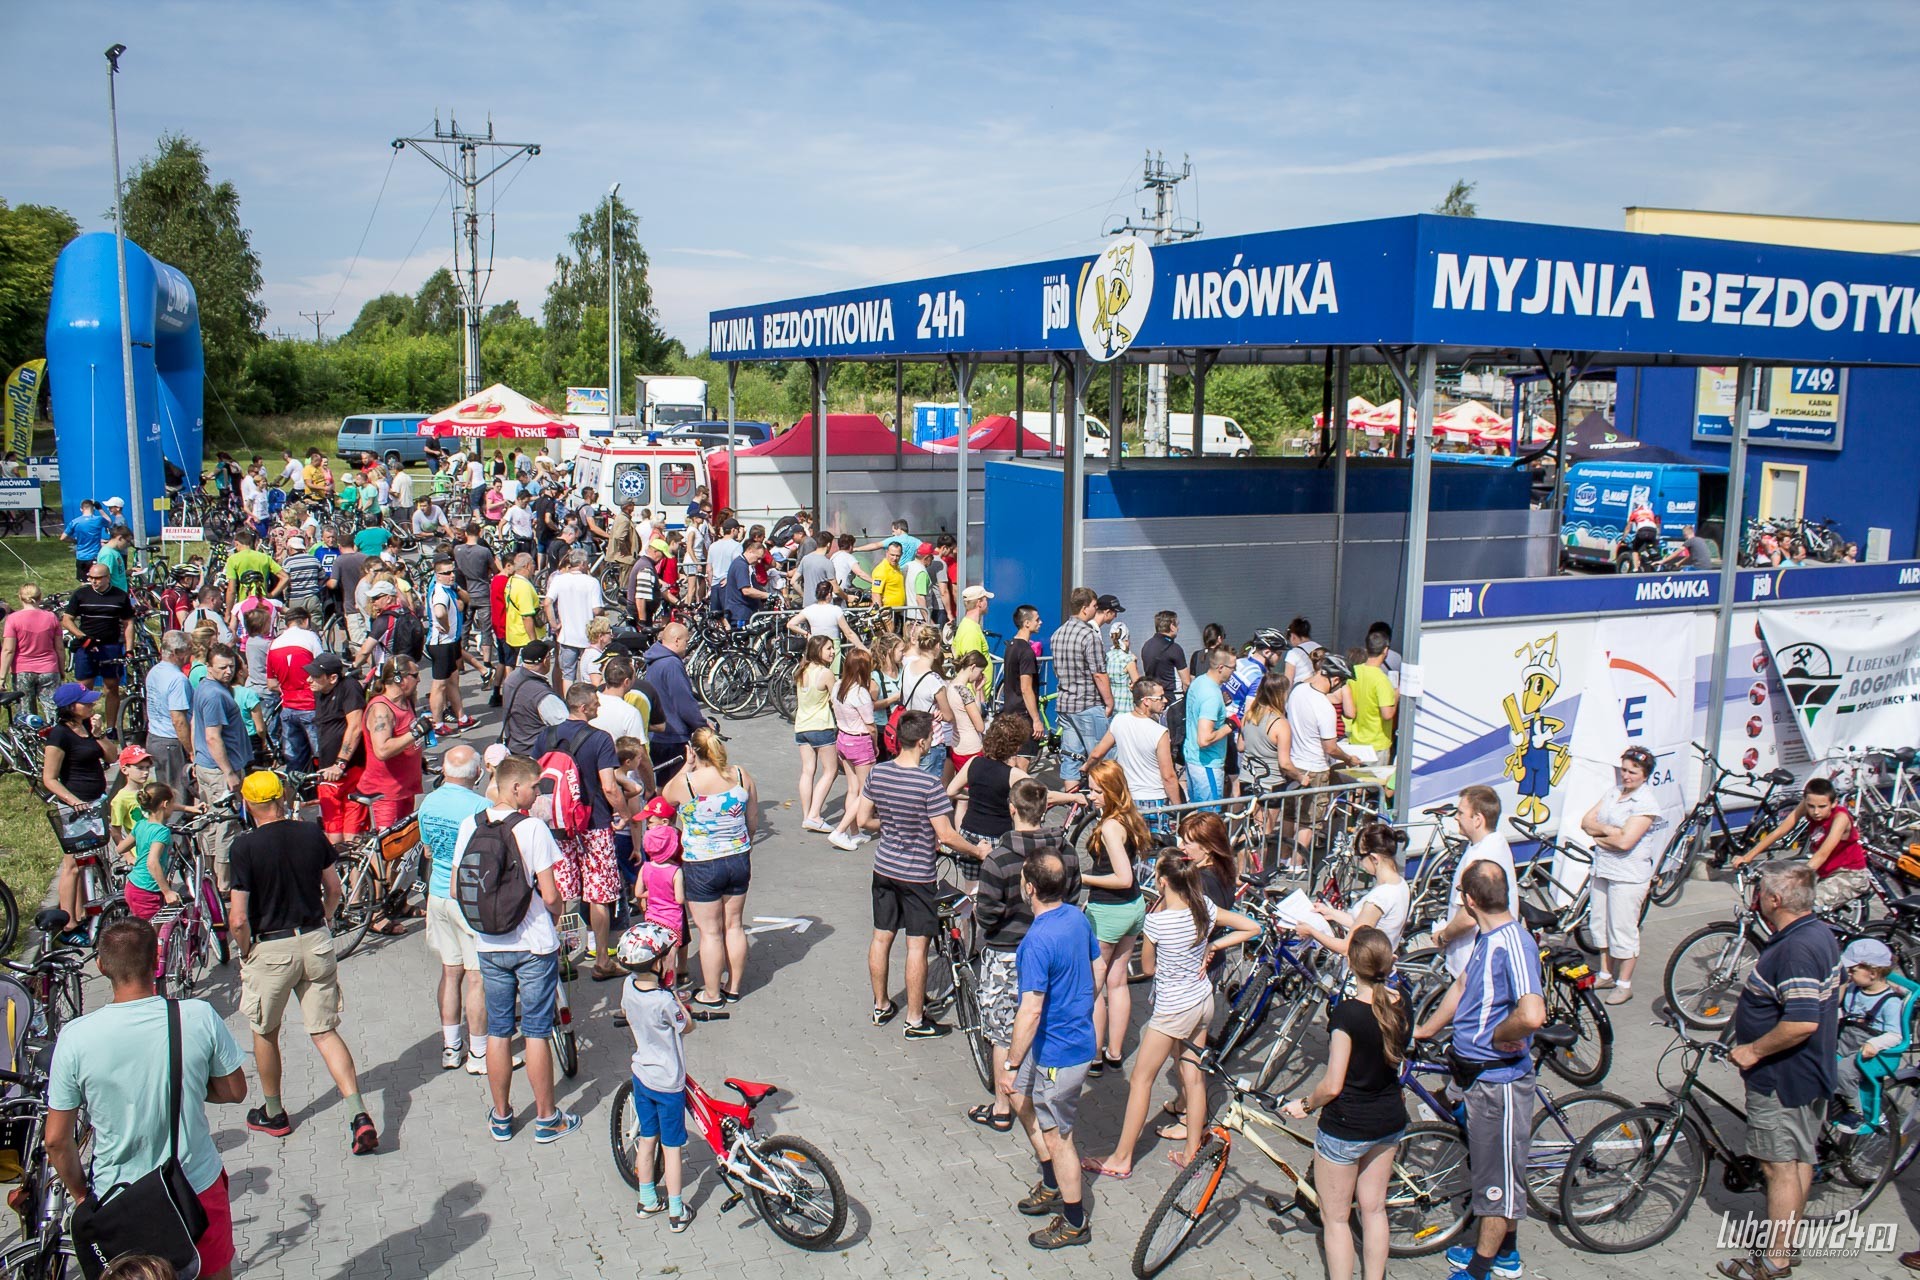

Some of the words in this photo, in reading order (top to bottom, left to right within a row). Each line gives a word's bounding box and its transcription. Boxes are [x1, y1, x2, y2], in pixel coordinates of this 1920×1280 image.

[1172, 253, 1339, 320] MRÓWKA
[1432, 253, 1655, 318] MYJNIA
[1677, 270, 1920, 335] BEZDOTYK
[711, 317, 756, 353] MYJNIA
[763, 298, 895, 349] BEZDOTYKOWA
[916, 290, 965, 339] 24h
[1042, 273, 1070, 340] psb
[451, 425, 488, 437] TYSKIE
[512, 426, 548, 438] TYSKIE
[1448, 587, 1473, 618] psb
[1751, 573, 1772, 601] psb
[1635, 577, 1709, 601] MRÓWKA
[1846, 654, 1901, 673] LUBELSKI
[565, 768, 581, 801] POLSKA
[1652, 768, 1675, 788] S.A.
